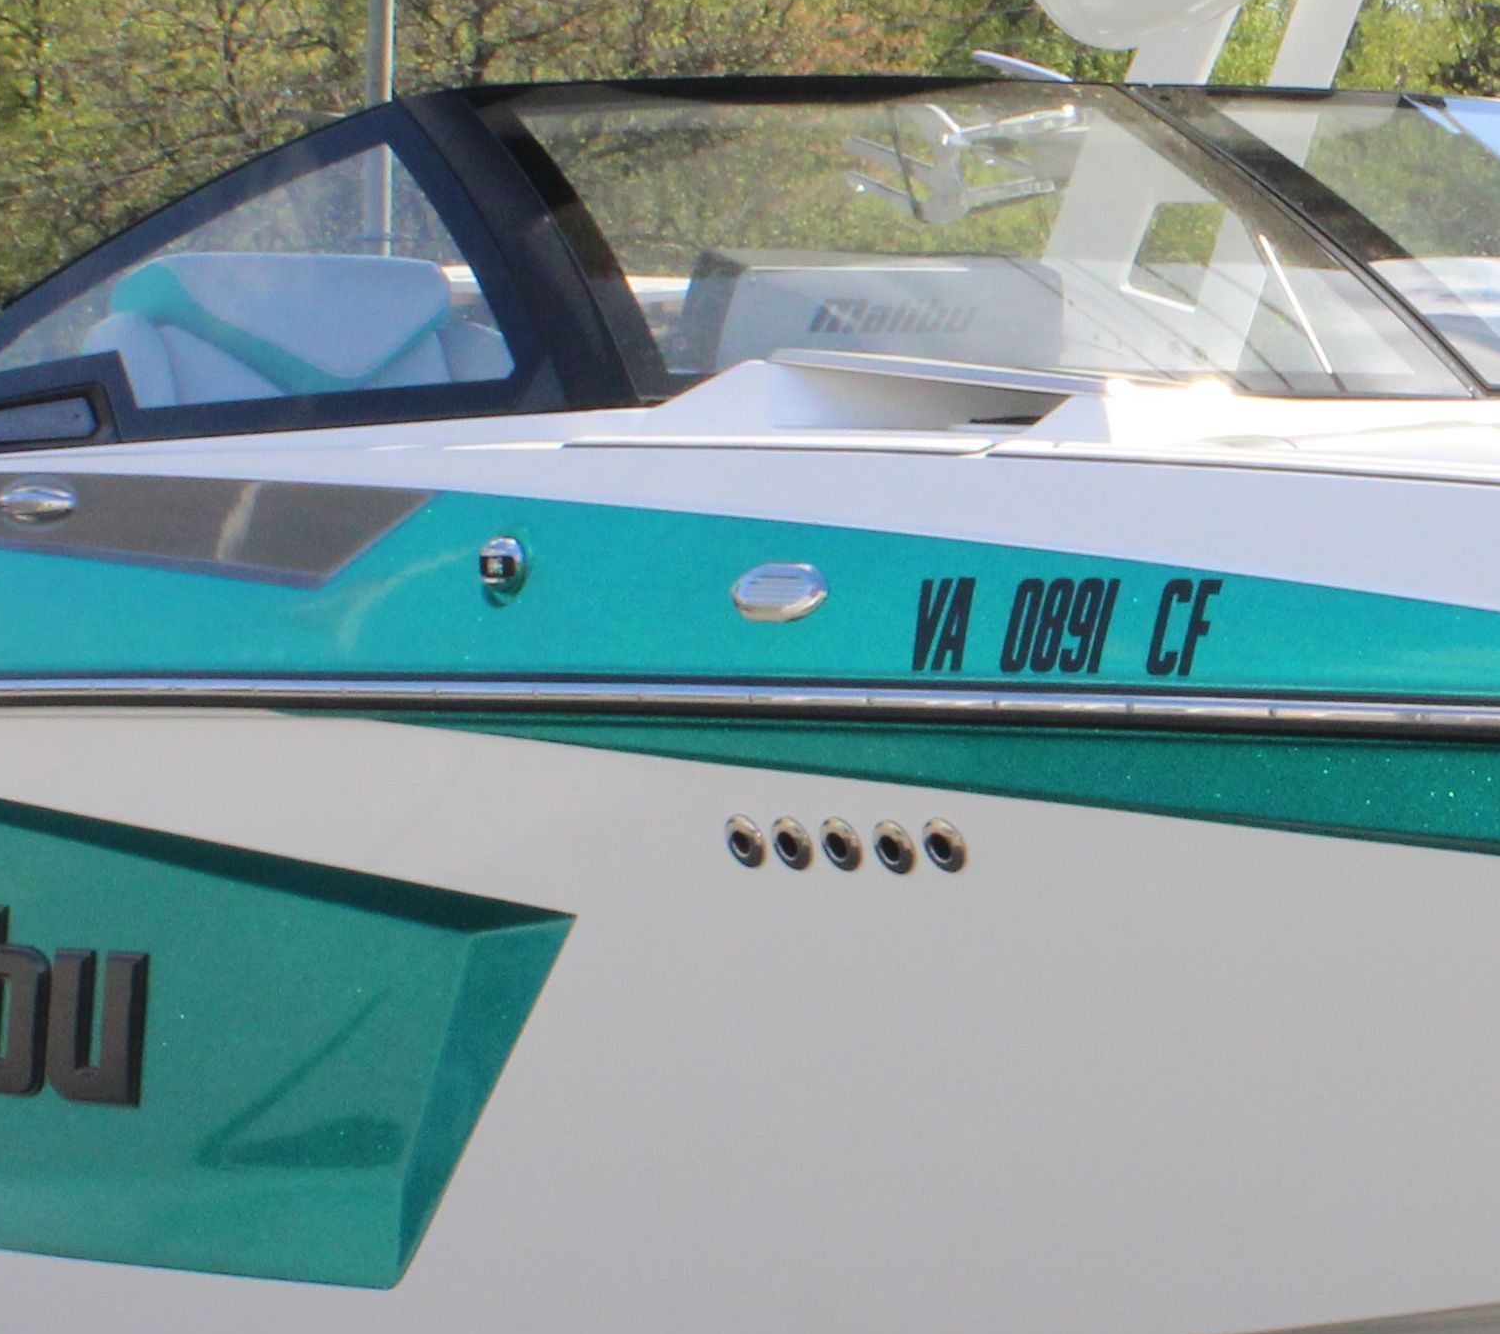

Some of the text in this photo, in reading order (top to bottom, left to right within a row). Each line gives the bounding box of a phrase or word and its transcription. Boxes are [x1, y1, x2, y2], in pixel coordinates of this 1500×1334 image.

[810, 298, 979, 333] Malibu
[911, 577, 1223, 676] VA 0891 CF
